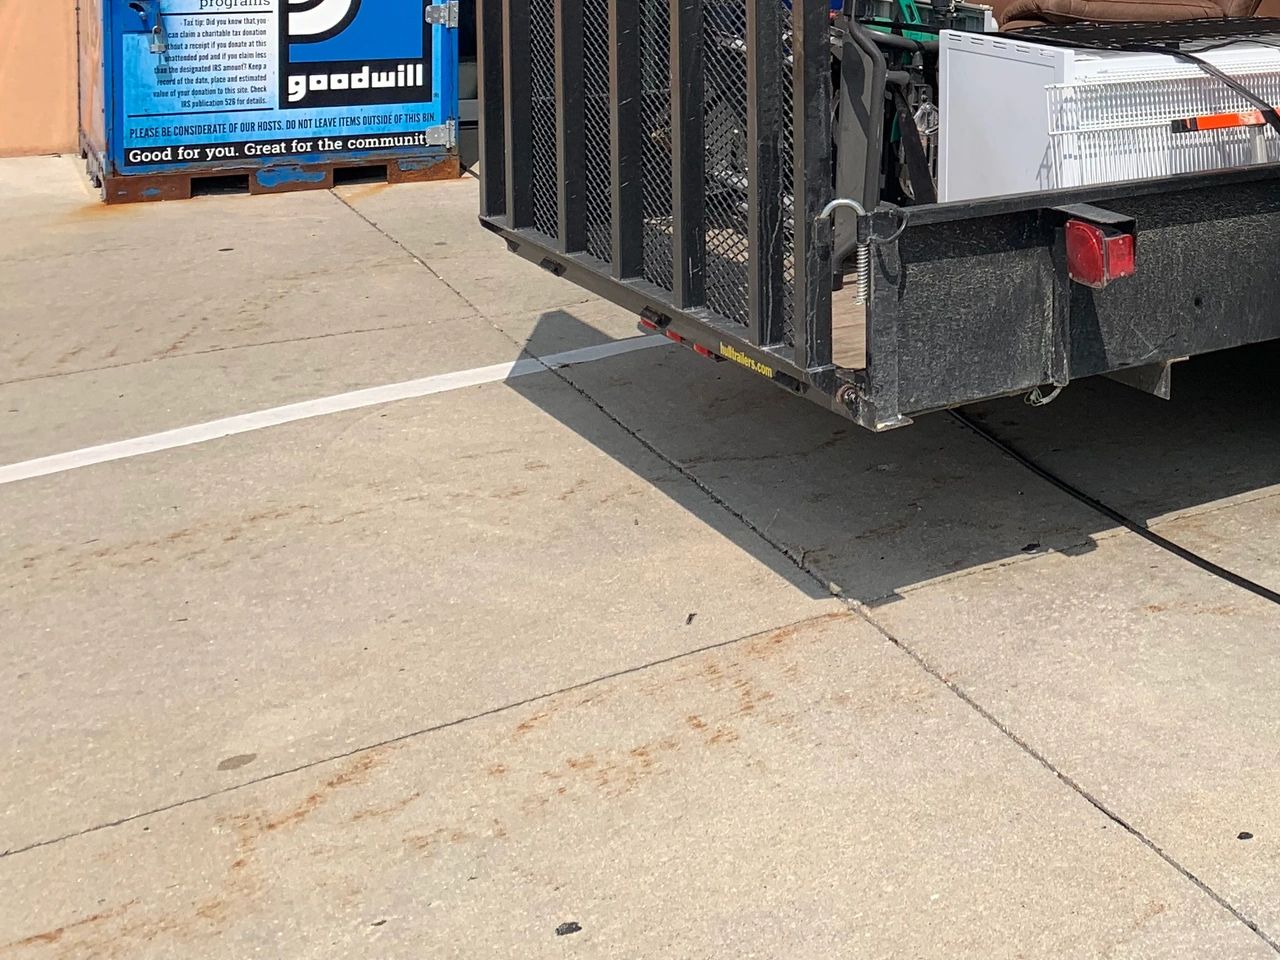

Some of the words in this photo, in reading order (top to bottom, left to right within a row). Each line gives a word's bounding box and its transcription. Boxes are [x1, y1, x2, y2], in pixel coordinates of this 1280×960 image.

[184, 18, 194, 26] Tax
[217, 19, 226, 27] you
[256, 18, 266, 26] you
[180, 30, 196, 38] claim
[202, 29, 230, 37] charitable
[242, 28, 266, 36] donation
[190, 42, 210, 50] receipt
[217, 42, 227, 50] you
[228, 40, 247, 48] donate
[198, 53, 208, 62] pod
[228, 53, 237, 61] you
[168, 66, 178, 74] the
[180, 64, 211, 74] designated
[212, 64, 222, 72] IRS
[223, 63, 247, 71] amount?
[248, 62, 262, 71] Keep
[157, 78, 176, 86] record
[195, 76, 209, 84] date,
[211, 76, 226, 84] place
[239, 74, 267, 82] estimated
[287, 63, 424, 103] goodwill
[153, 90, 168, 98] value
[170, 89, 176, 97] of
[178, 90, 190, 98] your
[192, 88, 216, 96] donation
[237, 86, 249, 94] site.
[250, 85, 267, 93] Check
[181, 100, 191, 108] IRS
[192, 99, 224, 109] publication
[129, 126, 160, 139] PLEASE
[161, 126, 172, 137] BE
[173, 123, 227, 136] CONSIDERATE
[228, 122, 239, 134] OF
[240, 121, 255, 133] OUR
[257, 120, 284, 131] HOSTS.
[285, 119, 296, 130] DO
[298, 118, 313, 129] NOT
[314, 116, 337, 128] LEAVE
[338, 115, 361, 127] ITEMS
[362, 114, 393, 125] OUTSIDE
[394, 113, 403, 124] OF
[404, 112, 421, 123] THIS
[422, 112, 436, 122] BIN.
[129, 147, 172, 163] Good
[177, 146, 201, 160] for
[205, 146, 239, 161] you.
[244, 141, 287, 156] Great
[291, 138, 316, 153] for
[317, 137, 343, 151] the
[720, 341, 773, 378] hulltrailers.com
